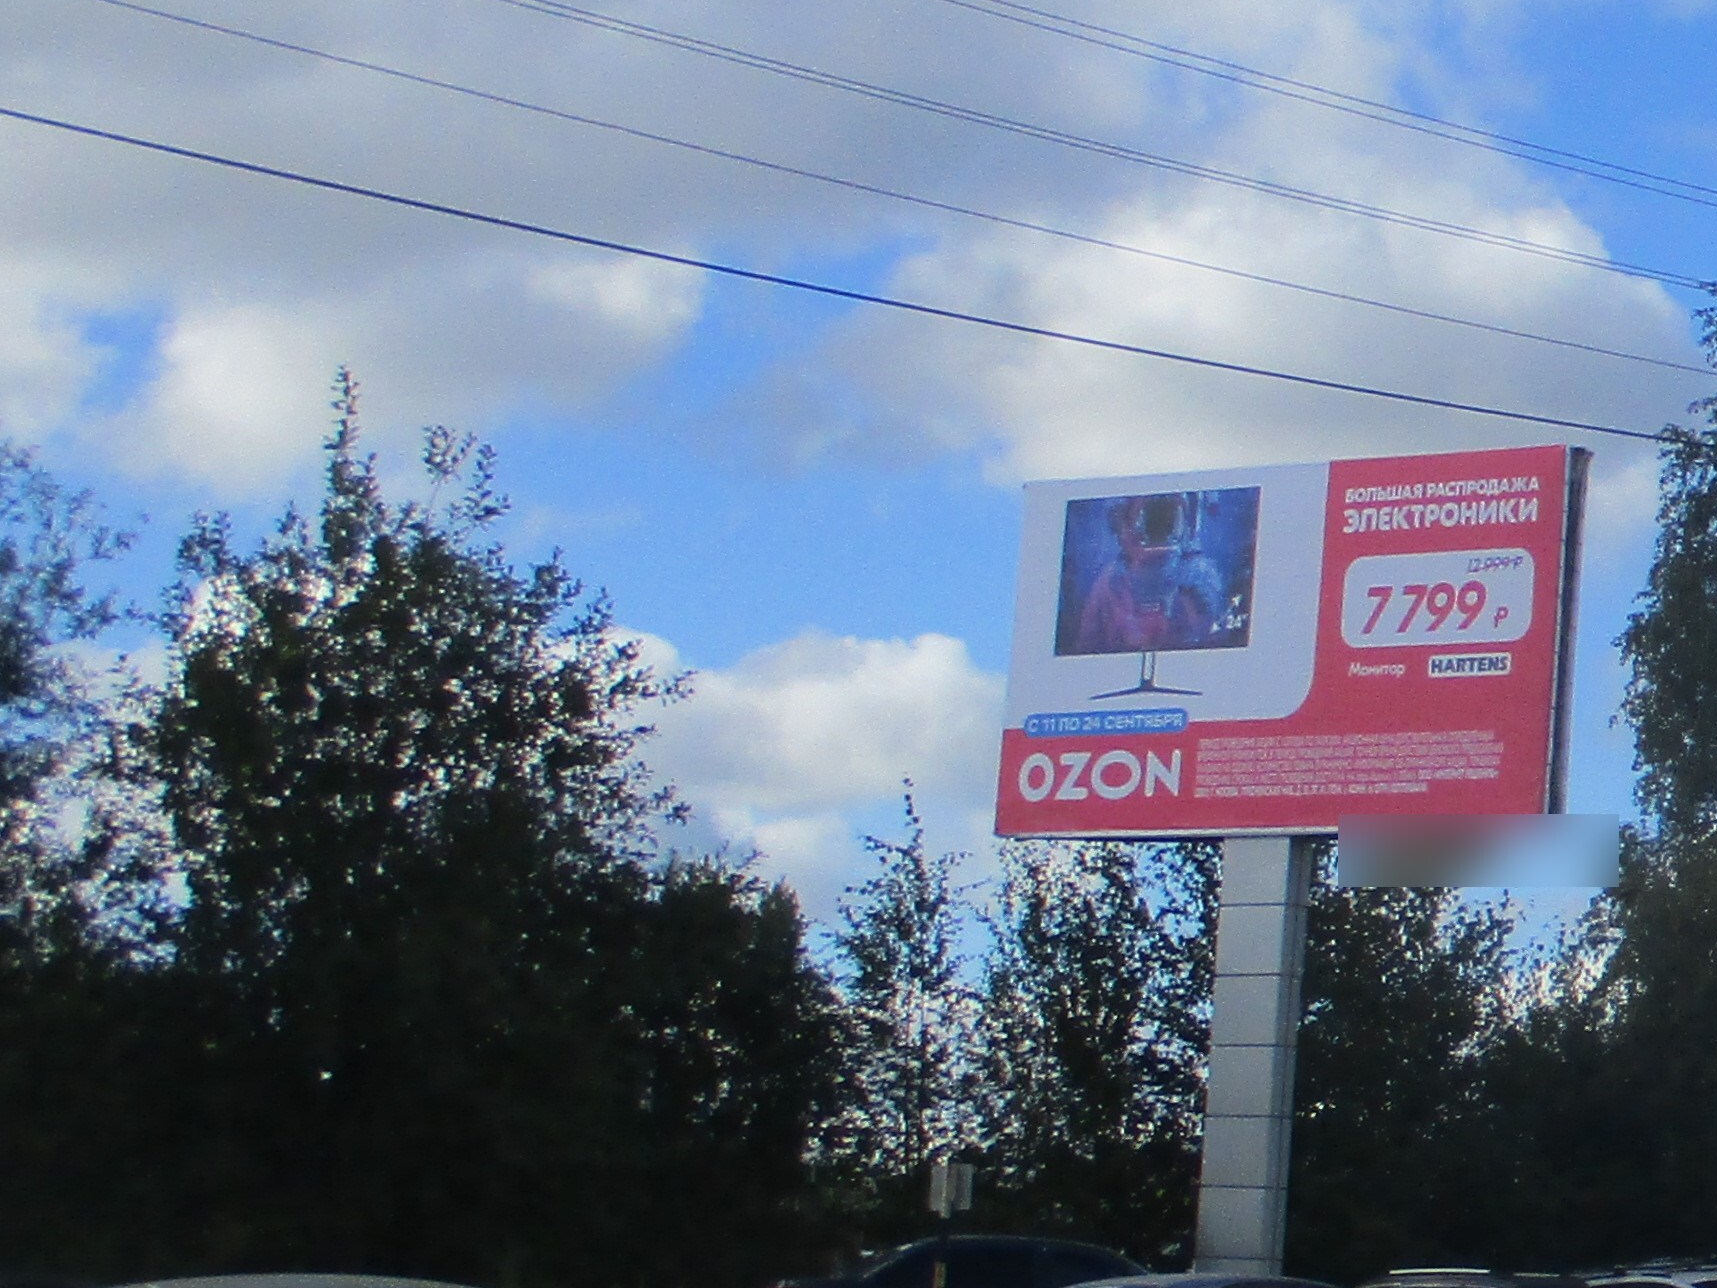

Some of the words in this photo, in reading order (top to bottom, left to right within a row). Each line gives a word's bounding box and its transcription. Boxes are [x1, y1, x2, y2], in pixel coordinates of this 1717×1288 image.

[1345, 484, 1424, 503] БОЛЬШАЯ
[1426, 477, 1540, 496] РАСПРОДАЖА
[1343, 498, 1538, 533] ЭЛЕКТРОНИКИ
[1348, 662, 1406, 679] Монитор
[1430, 656, 1509, 674] HARTENS
[1103, 713, 1184, 729] СЕНТЯБРЯ
[1018, 748, 1183, 803] OZON
